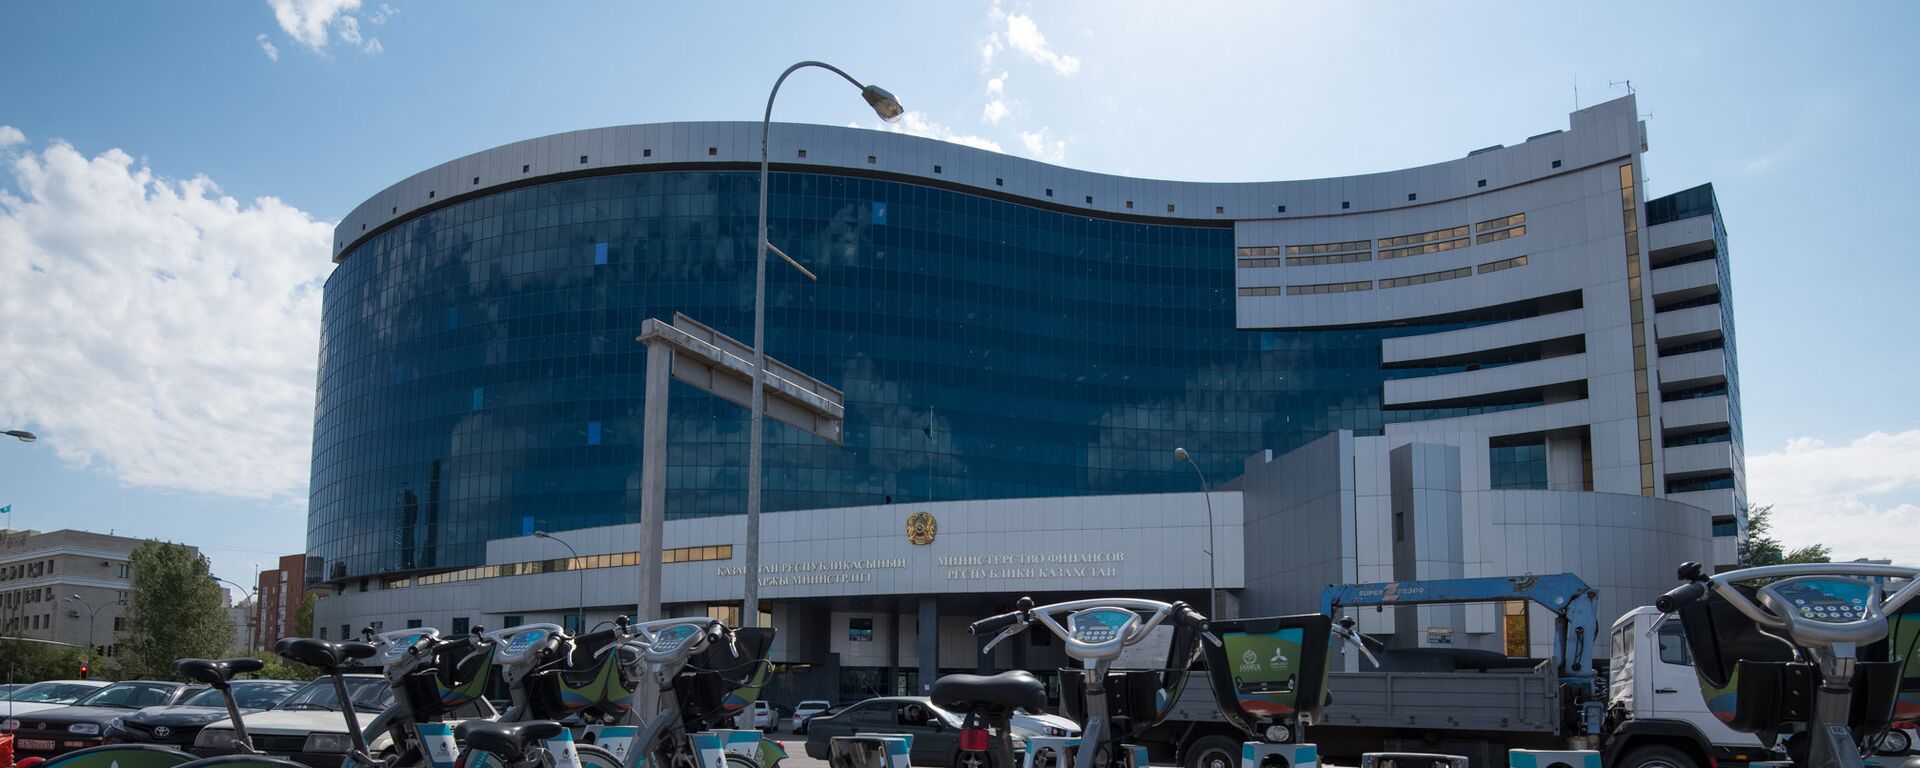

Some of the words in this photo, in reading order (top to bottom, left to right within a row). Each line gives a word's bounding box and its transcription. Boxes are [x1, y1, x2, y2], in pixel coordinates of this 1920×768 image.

[938, 553, 1045, 567] МИНИСТЕРСТВО
[1047, 552, 1125, 563] ФИНАНСОВ
[717, 563, 778, 577] ҚАЗАТАН
[782, 558, 907, 573] РЕСПУБЛИКАСЫНЫҢ
[947, 568, 1035, 580] РЕСПУБЛИКИ
[1039, 566, 1117, 578] КАЗАХСТАН
[757, 575, 789, 587] АРЖЫ
[1359, 589, 1383, 597] SUPER
